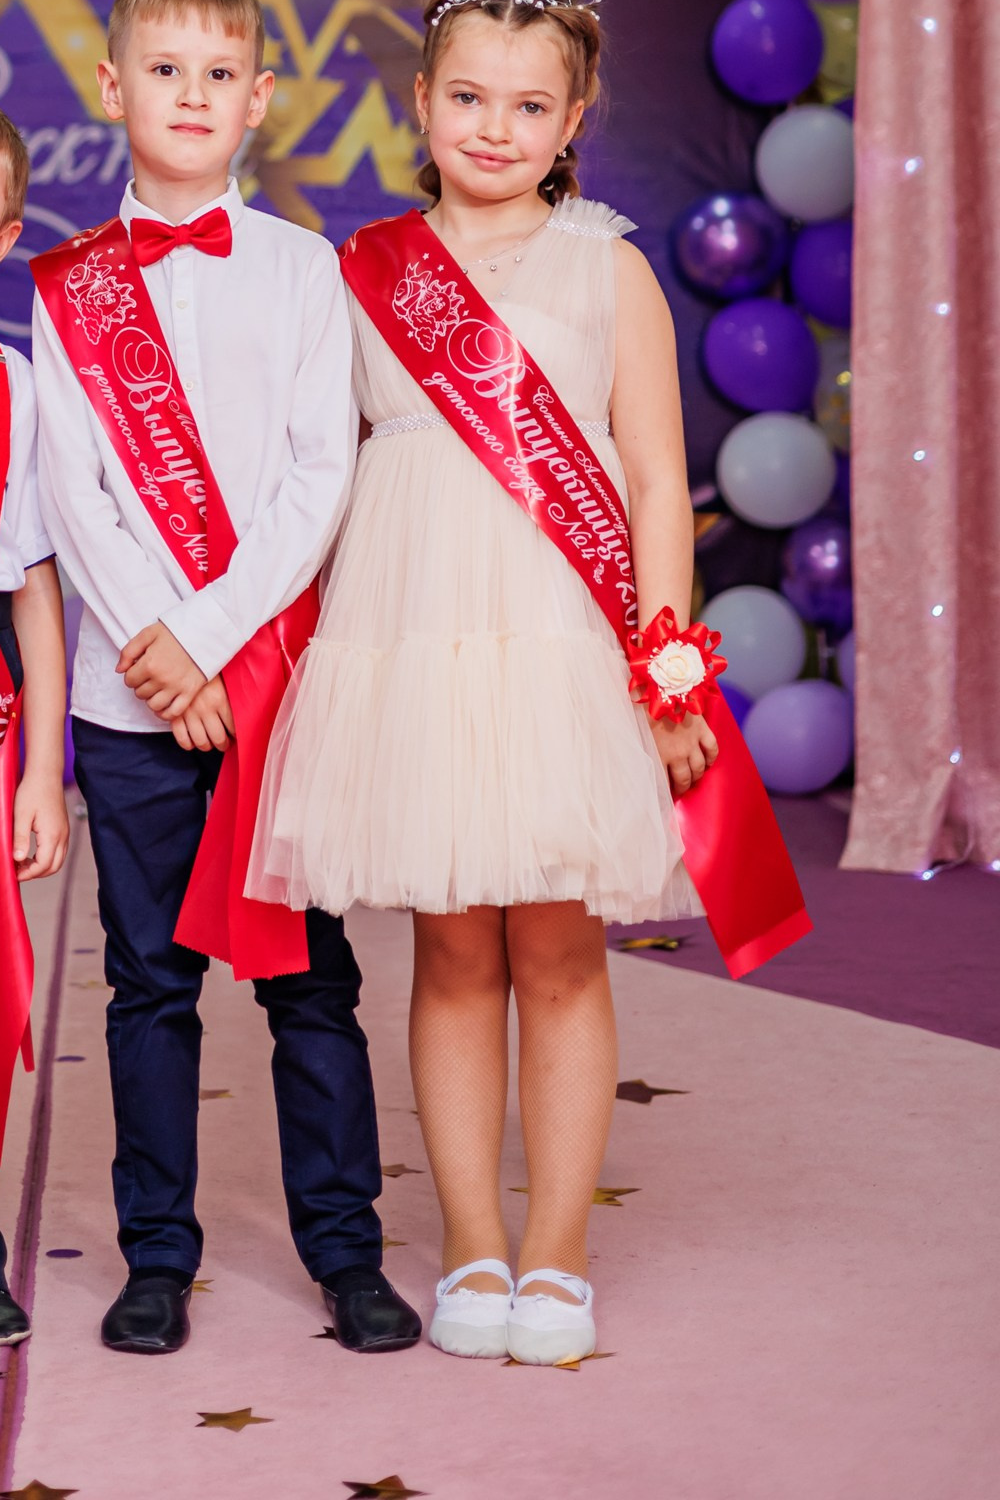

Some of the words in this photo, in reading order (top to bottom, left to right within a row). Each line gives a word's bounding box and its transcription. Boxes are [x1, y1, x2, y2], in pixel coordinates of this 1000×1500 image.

[78, 363, 141, 458] детского
[138, 461, 169, 510] сада
[421, 371, 505, 454] детского
[503, 456, 548, 502] сада
[446, 318, 631, 577] Выпускница
